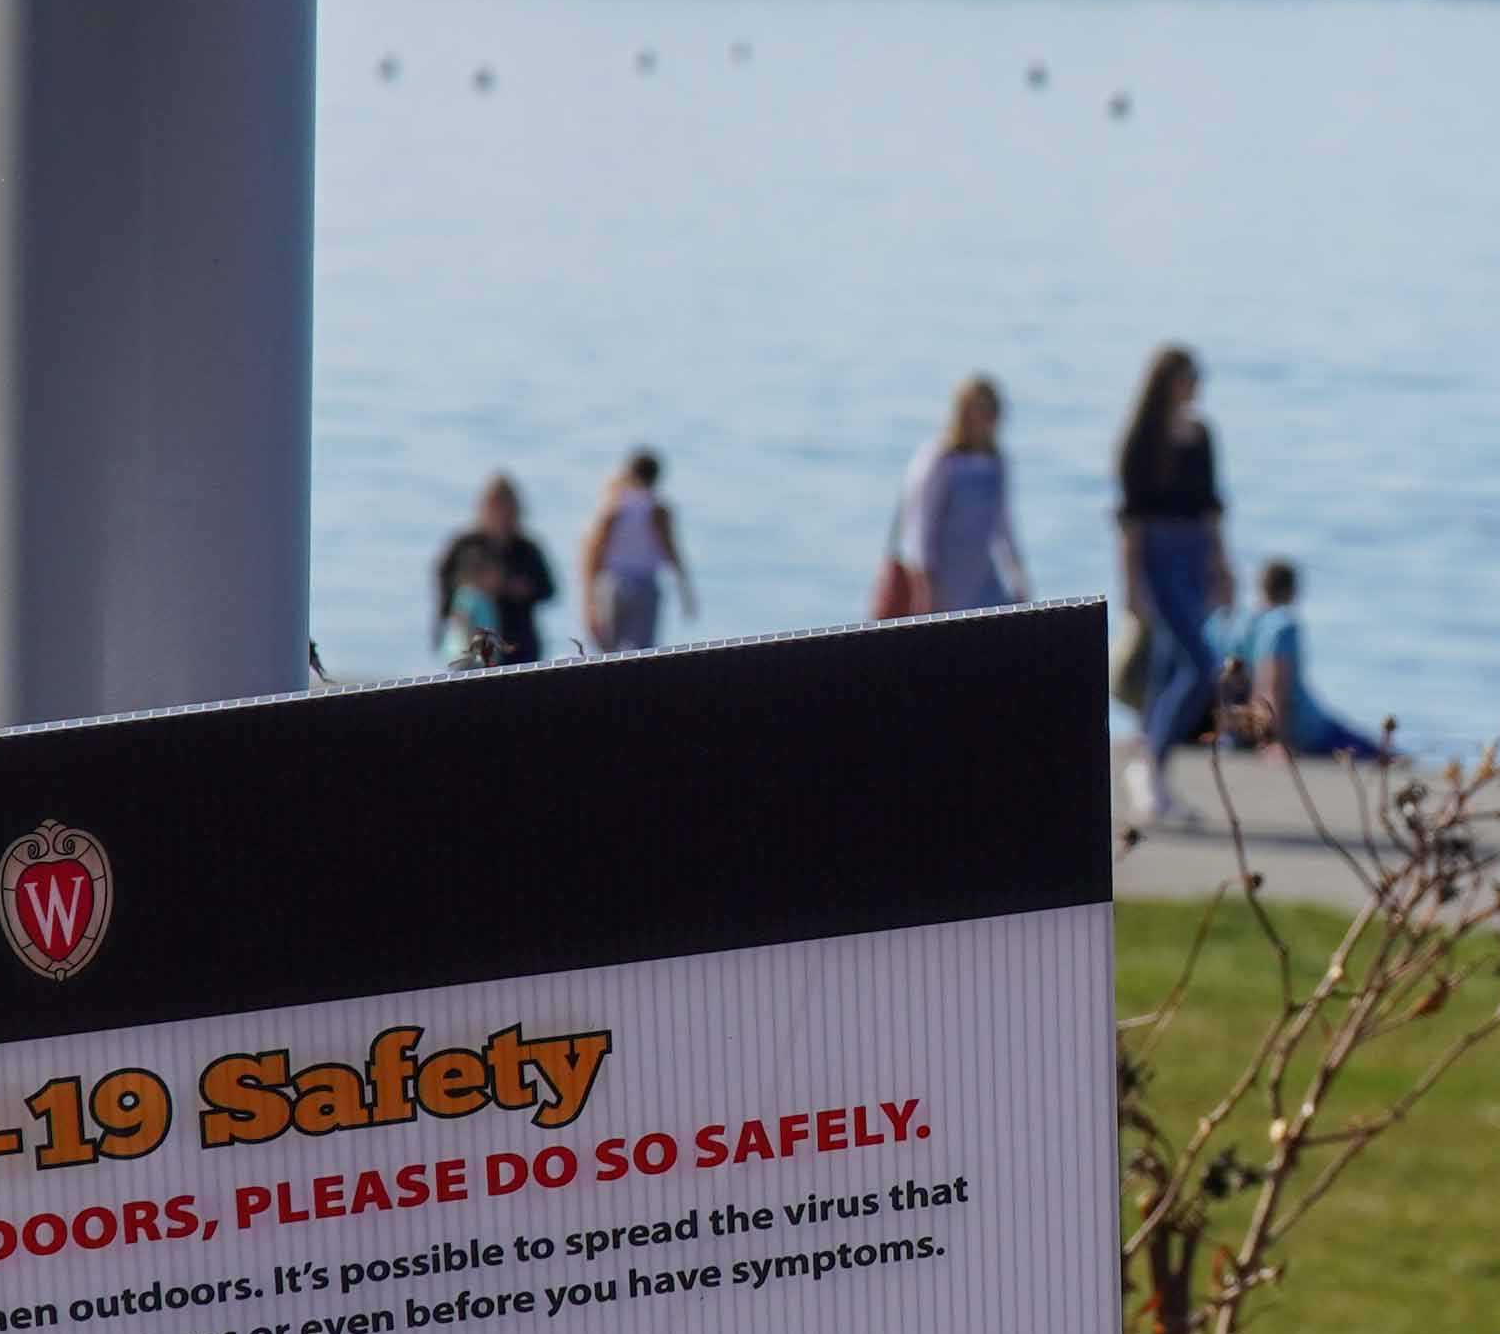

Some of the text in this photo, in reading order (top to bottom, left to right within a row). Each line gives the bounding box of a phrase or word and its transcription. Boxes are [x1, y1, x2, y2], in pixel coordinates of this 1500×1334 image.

[23, 874, 85, 949] W
[199, 1021, 613, 1149] Safety
[234, 1158, 469, 1231] PLEASE
[485, 1145, 579, 1197] DO
[594, 1132, 679, 1182] SO
[694, 1098, 932, 1169] SAFELY.
[68, 1277, 264, 1323] outdoors.
[339, 1237, 505, 1295] possible
[512, 1235, 556, 1263] to
[565, 1208, 700, 1261] spread
[708, 1203, 774, 1237] the
[782, 1192, 880, 1226] virus
[888, 1175, 969, 1212] that
[405, 1289, 536, 1329] before
[543, 1279, 618, 1318] you
[628, 1265, 722, 1299] have
[731, 1236, 946, 1290] symptoms.
